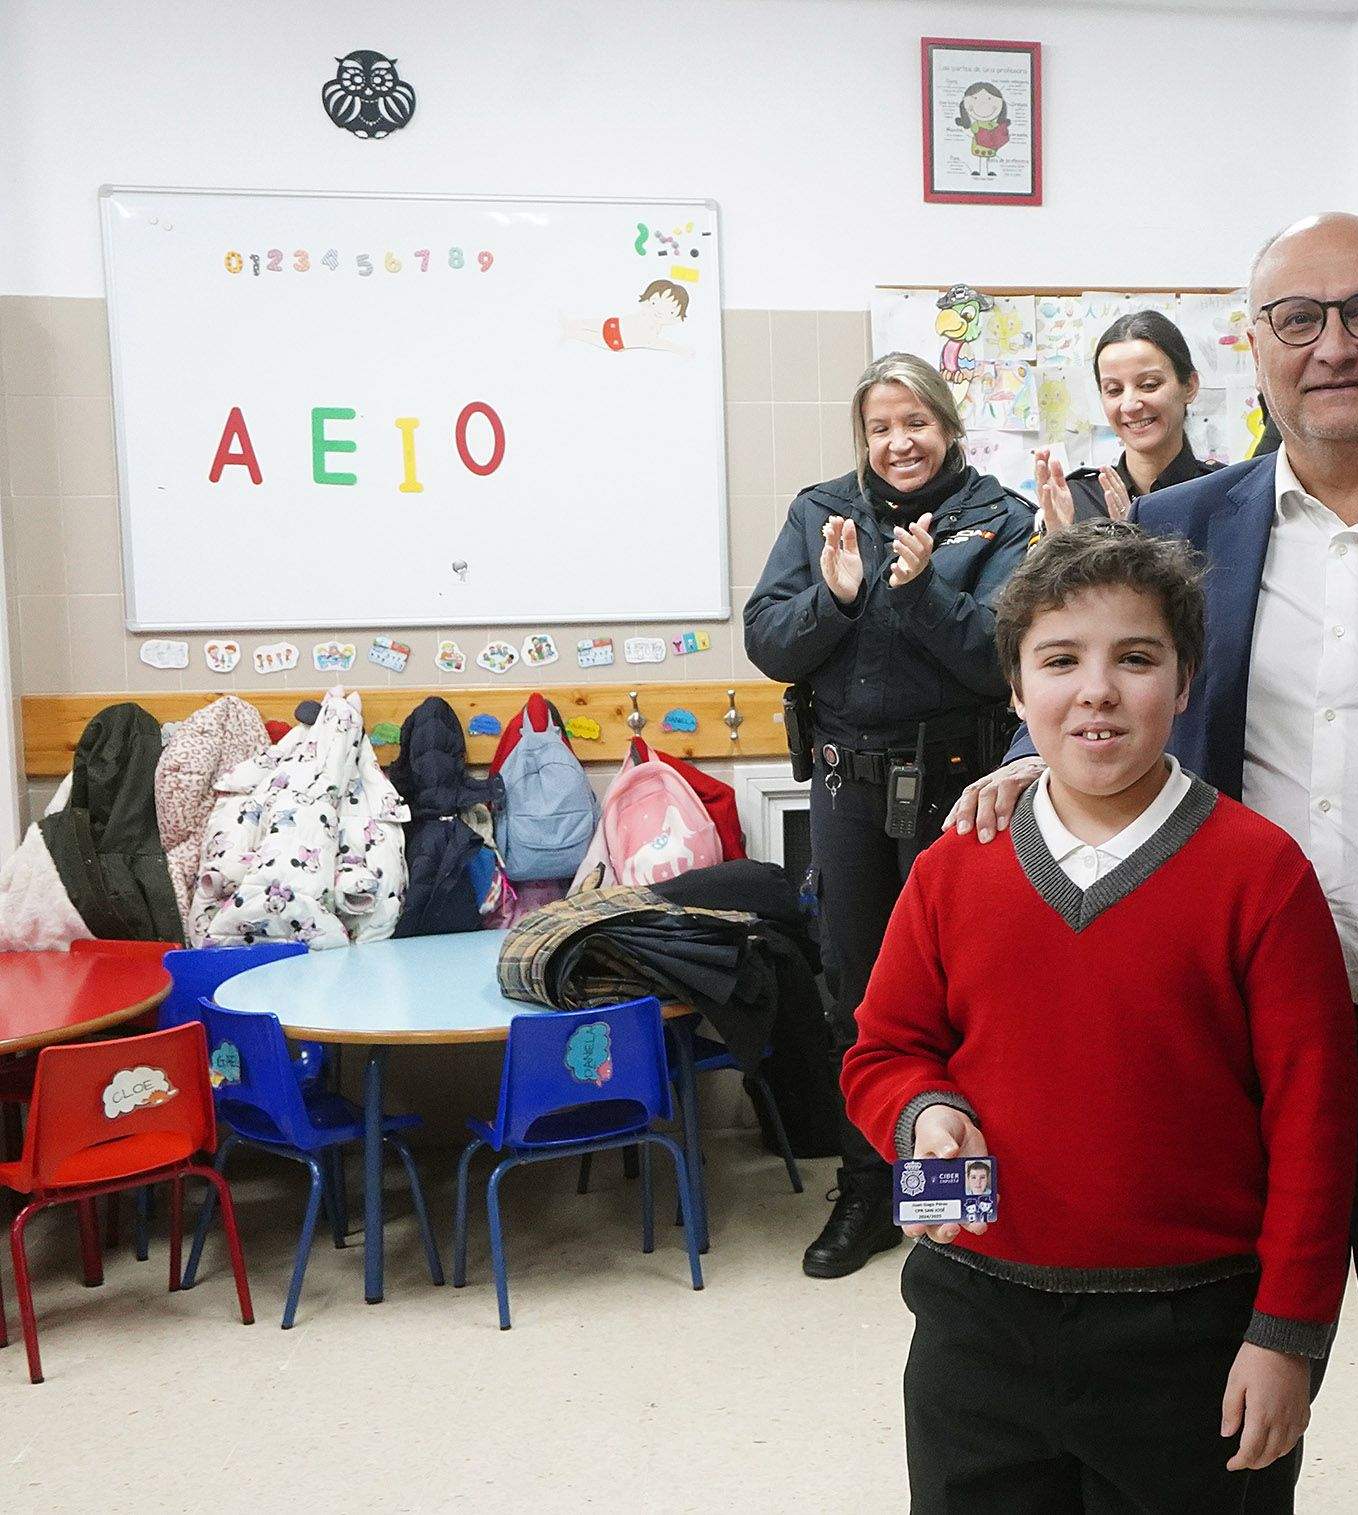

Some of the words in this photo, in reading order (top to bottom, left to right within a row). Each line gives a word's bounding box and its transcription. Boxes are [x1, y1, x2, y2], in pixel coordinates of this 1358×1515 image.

[224, 251, 244, 274] 0
[267, 249, 283, 272] 2
[293, 250, 311, 272] 3
[356, 253, 373, 277] 5
[385, 251, 402, 273] 6
[414, 249, 430, 272] 7
[448, 247, 465, 269] 8
[478, 251, 494, 272] 9
[208, 406, 263, 485] A
[311, 407, 358, 485] E
[395, 417, 425, 494] I
[455, 401, 505, 477] O
[112, 1080, 155, 1104] CLOE
